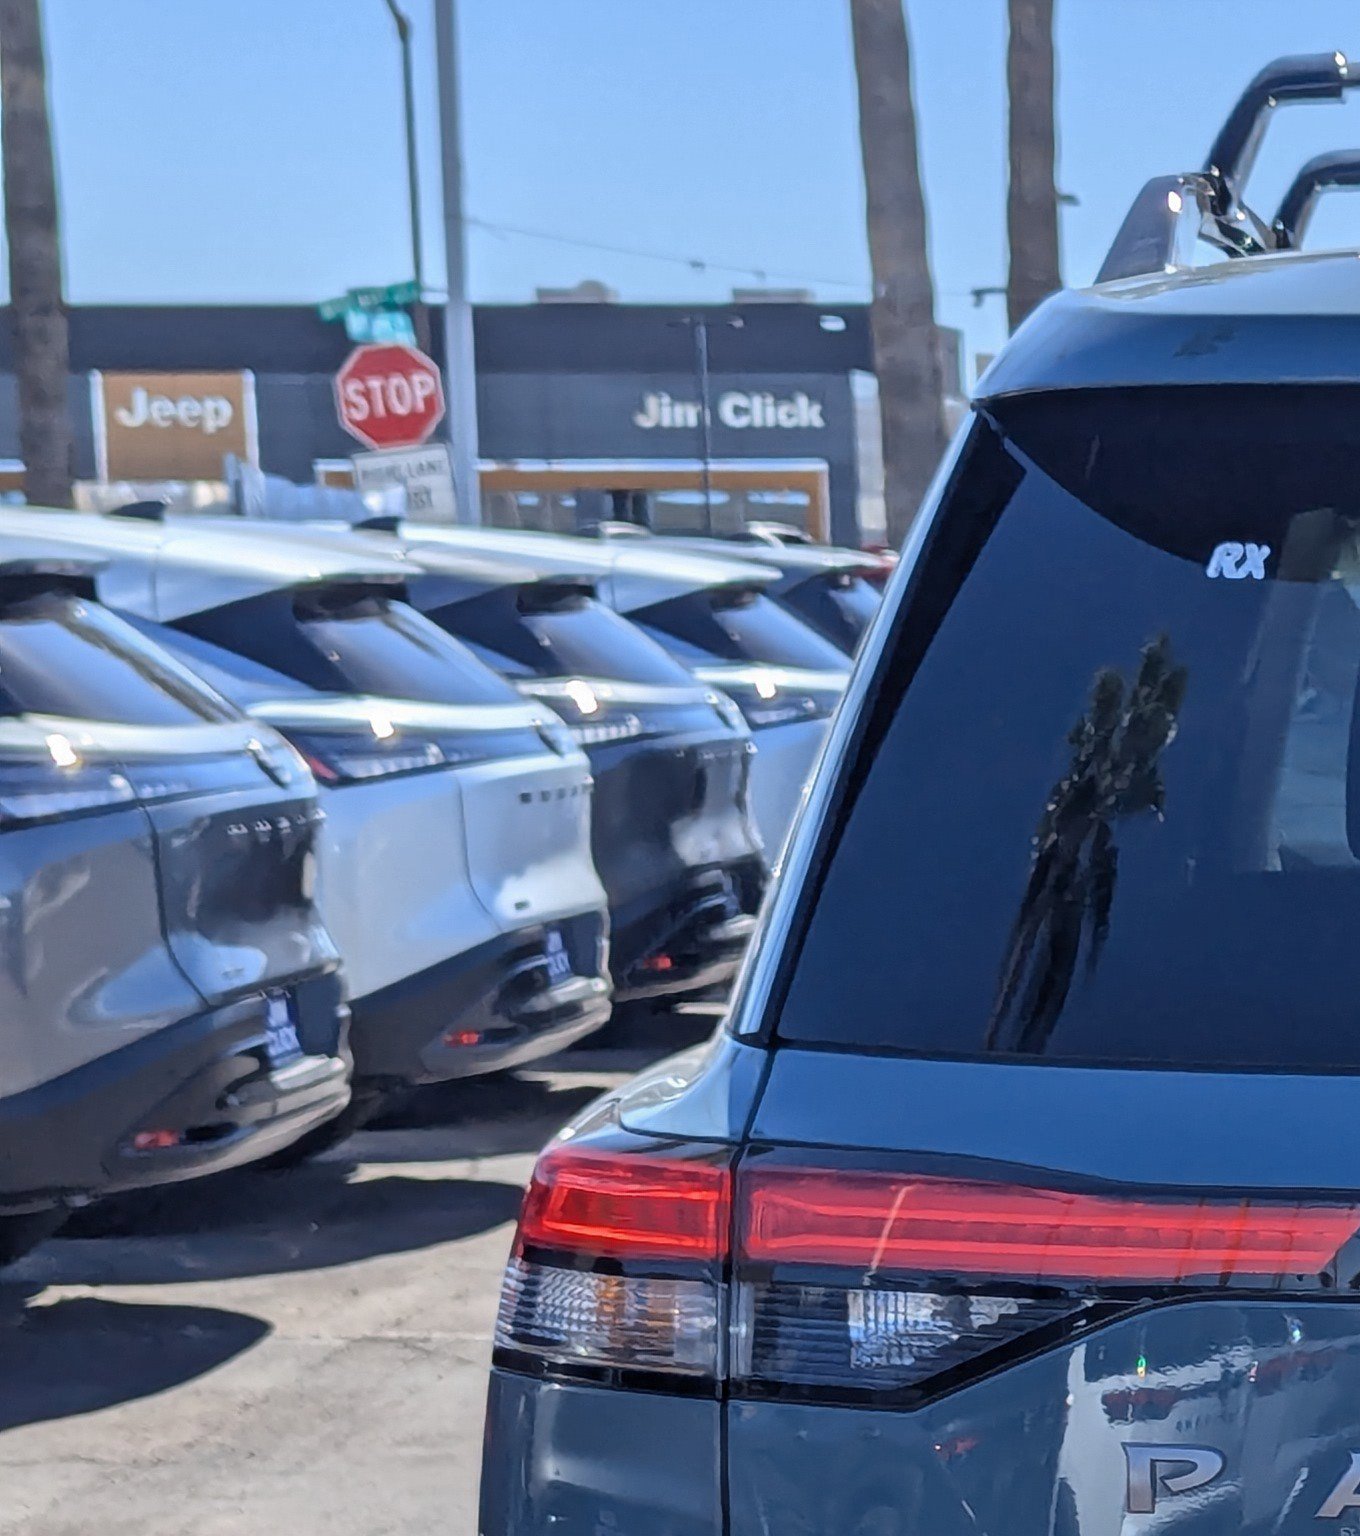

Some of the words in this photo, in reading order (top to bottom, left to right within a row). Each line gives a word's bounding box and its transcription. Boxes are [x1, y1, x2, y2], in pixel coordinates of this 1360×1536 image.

[114, 386, 233, 434] Jeep
[345, 372, 435, 421] STOP
[634, 391, 711, 428] Jim
[718, 391, 826, 428] Click
[1206, 541, 1271, 580] RX
